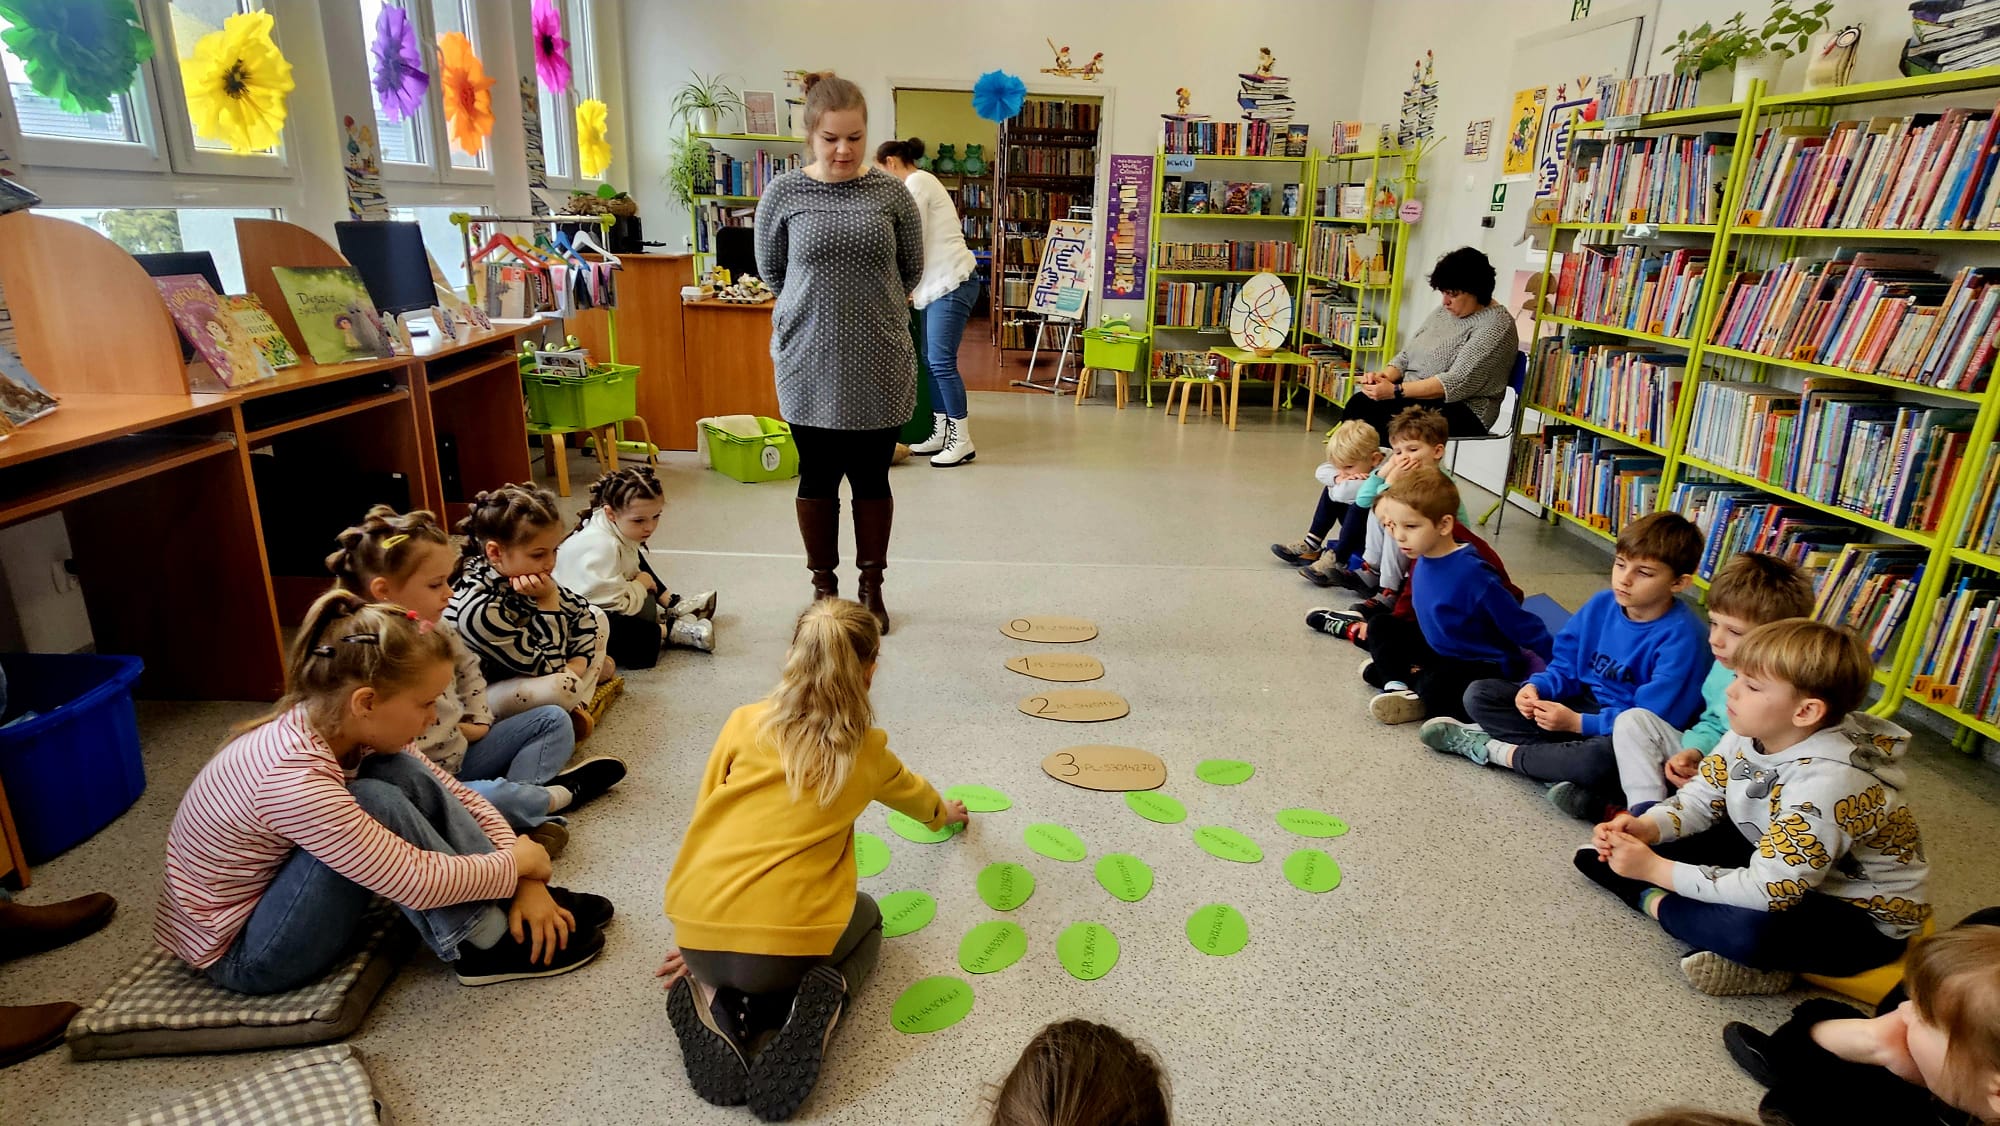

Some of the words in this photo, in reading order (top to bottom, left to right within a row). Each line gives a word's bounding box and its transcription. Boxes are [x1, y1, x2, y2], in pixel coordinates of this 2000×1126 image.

[1630, 211, 1637, 221] B
[1741, 213, 1754, 225] K
[1651, 323, 1660, 334] C
[1796, 349, 1811, 361] M
[1525, 488, 1534, 497] G
[1557, 503, 1565, 512] H
[1598, 520, 1605, 529] J
[1018, 657, 1030, 671] 1
[1915, 679, 1928, 692] U
[1931, 687, 1949, 700] W
[1029, 697, 1058, 714] 2
